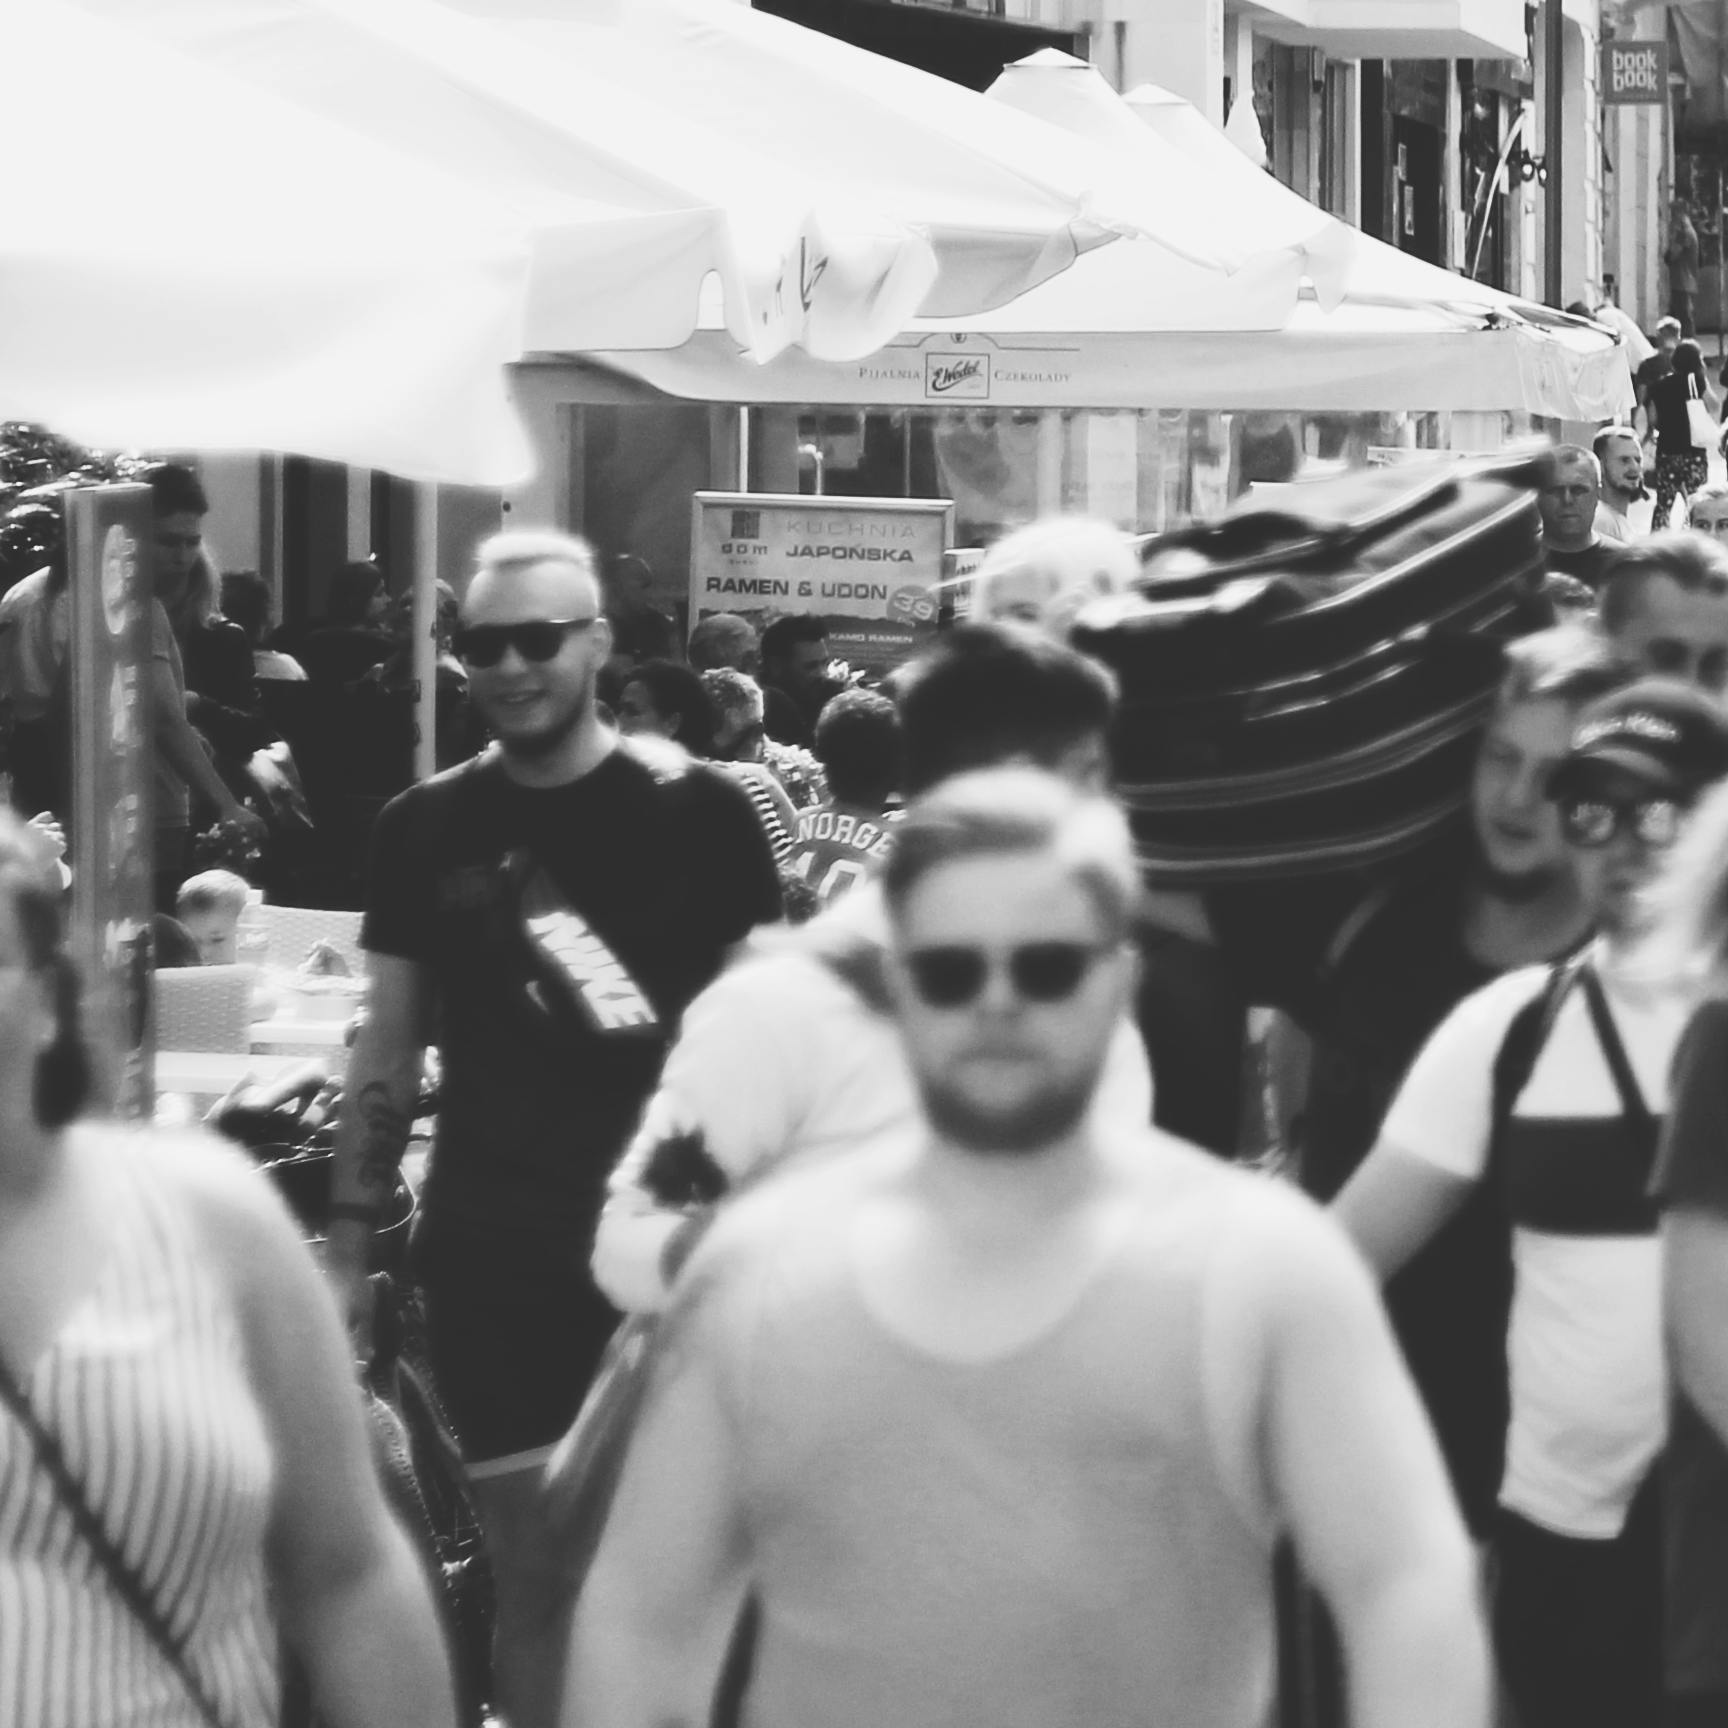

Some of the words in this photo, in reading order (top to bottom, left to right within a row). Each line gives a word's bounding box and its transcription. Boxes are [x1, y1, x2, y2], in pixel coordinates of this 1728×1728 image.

[1612, 48, 1657, 70] book
[1613, 71, 1657, 91] book
[785, 520, 917, 539] KUCHNIA
[785, 542, 915, 563] JAPOŃSKA
[706, 576, 789, 597] RAMEN
[797, 580, 813, 597] &
[821, 582, 888, 601] UDON
[893, 593, 934, 620] 39
[795, 812, 894, 859] NORGE
[526, 911, 658, 1030] NIKE
